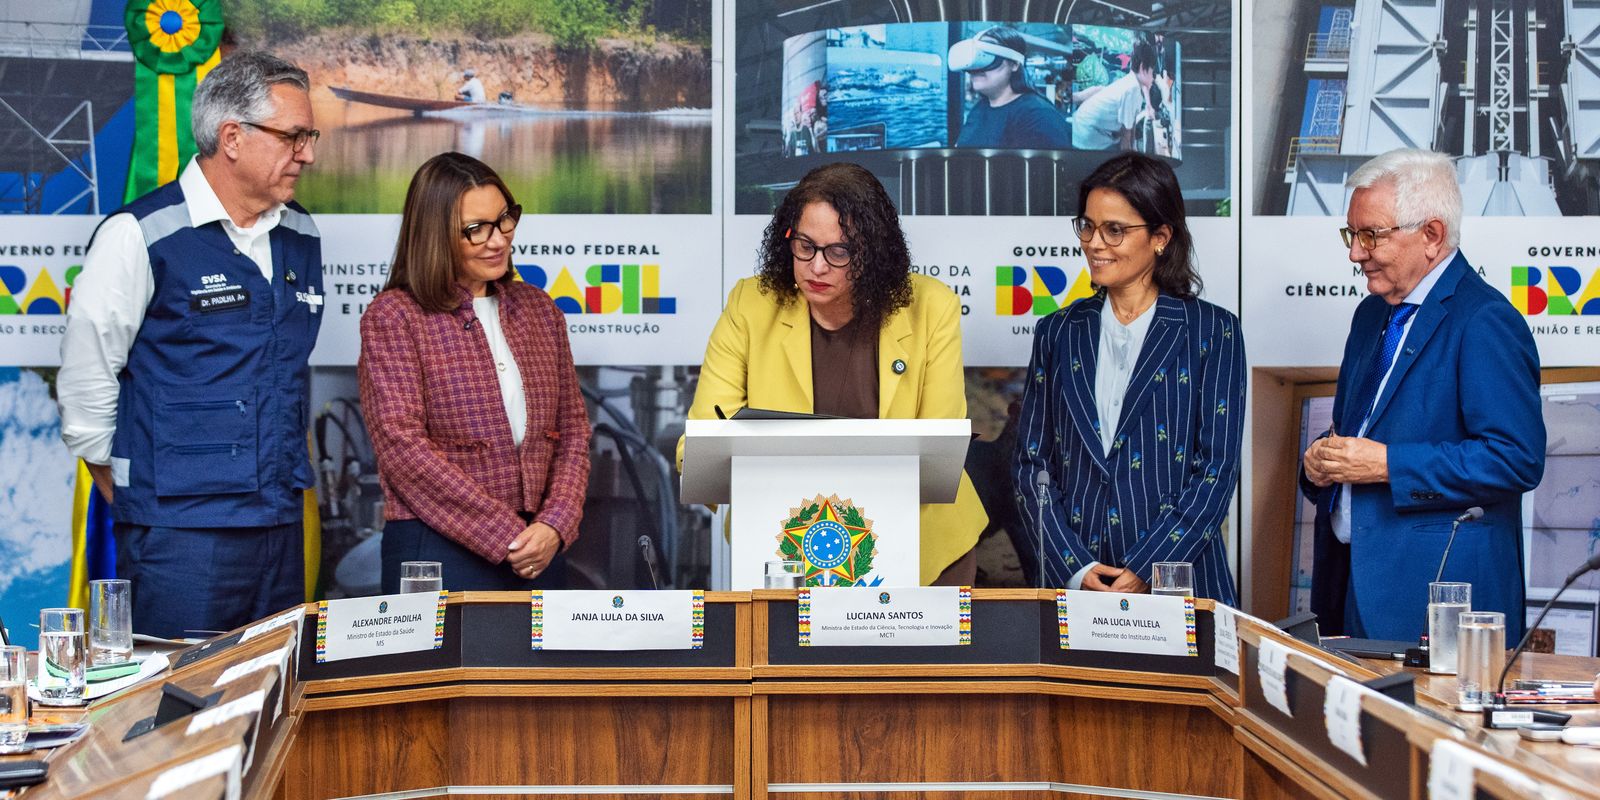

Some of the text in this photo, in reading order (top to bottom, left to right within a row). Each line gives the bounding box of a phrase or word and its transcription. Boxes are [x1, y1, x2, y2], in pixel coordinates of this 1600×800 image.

[584, 245, 660, 255] FEDERAL
[1528, 246, 1600, 257] GOVERN
[949, 265, 971, 277] DA
[201, 273, 227, 285] SVSA
[1285, 282, 1364, 298] CIÊNCIA,
[211, 294, 236, 305] PADILHA
[342, 303, 350, 314] E
[1574, 326, 1581, 335] E
[352, 613, 422, 628] ALEXANDRE PADILHA
[571, 613, 665, 621] JANJA LULA DA SILVA
[846, 611, 924, 620] LUCIANA SANTOS
[876, 624, 897, 632] Ciência,
[930, 623, 953, 631] Inovação
[1092, 617, 1161, 629] ANA LUCIA VILLELA
[347, 632, 367, 640] Ministro
[375, 629, 392, 638] Estado
[399, 626, 415, 635] Saúde
[1091, 631, 1119, 640] Presidente
[1128, 633, 1150, 641] Instituto
[1151, 634, 1167, 642] Alana
